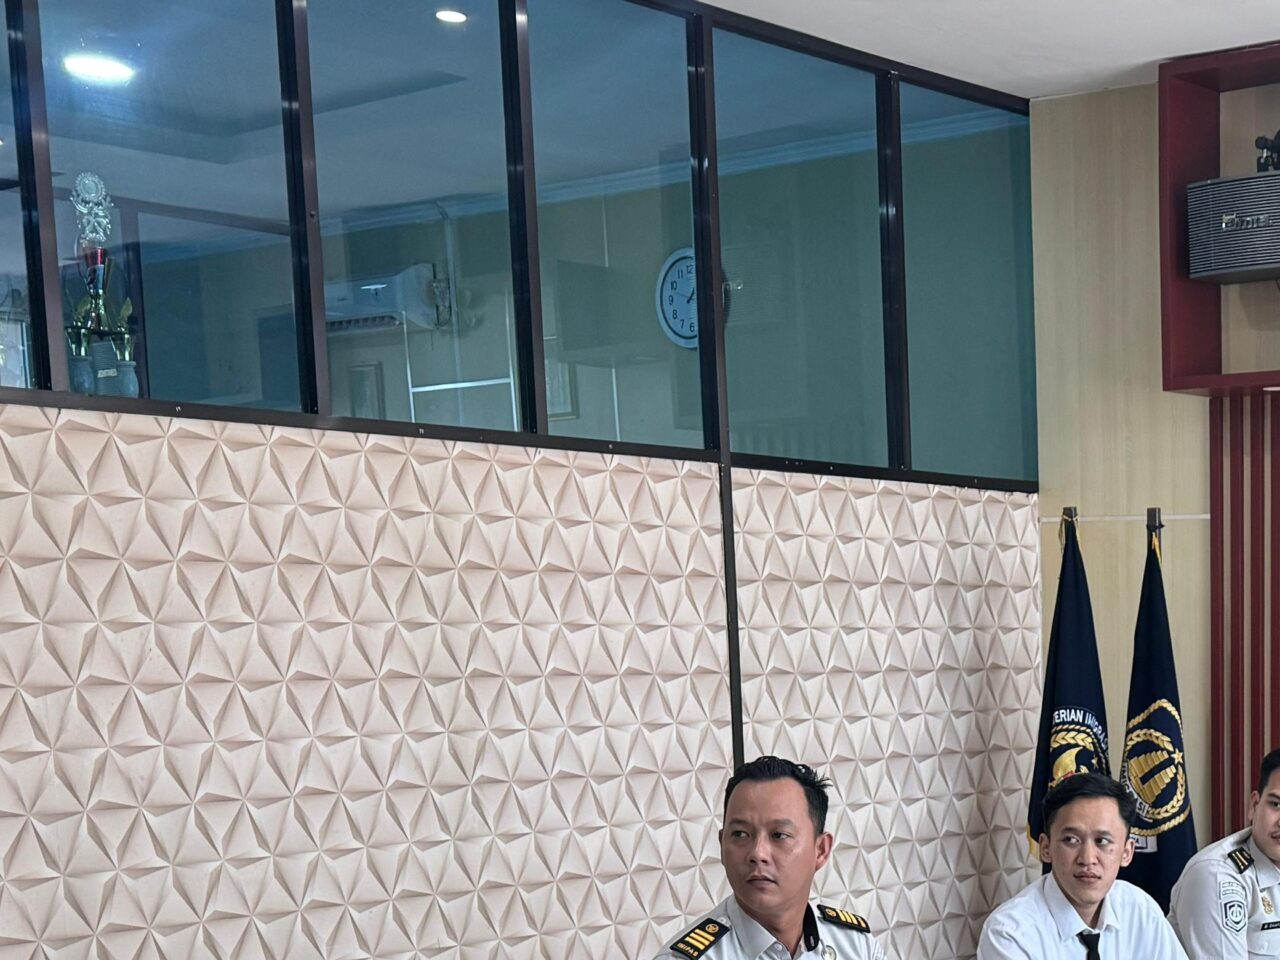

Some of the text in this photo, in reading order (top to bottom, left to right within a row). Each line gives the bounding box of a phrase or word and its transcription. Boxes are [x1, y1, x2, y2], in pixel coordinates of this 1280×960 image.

[677, 269, 684, 279] 11
[670, 280, 678, 291] 10
[668, 295, 674, 306] 9
[672, 309, 678, 320] 8
[680, 319, 685, 329] 7
[689, 322, 695, 333] 6
